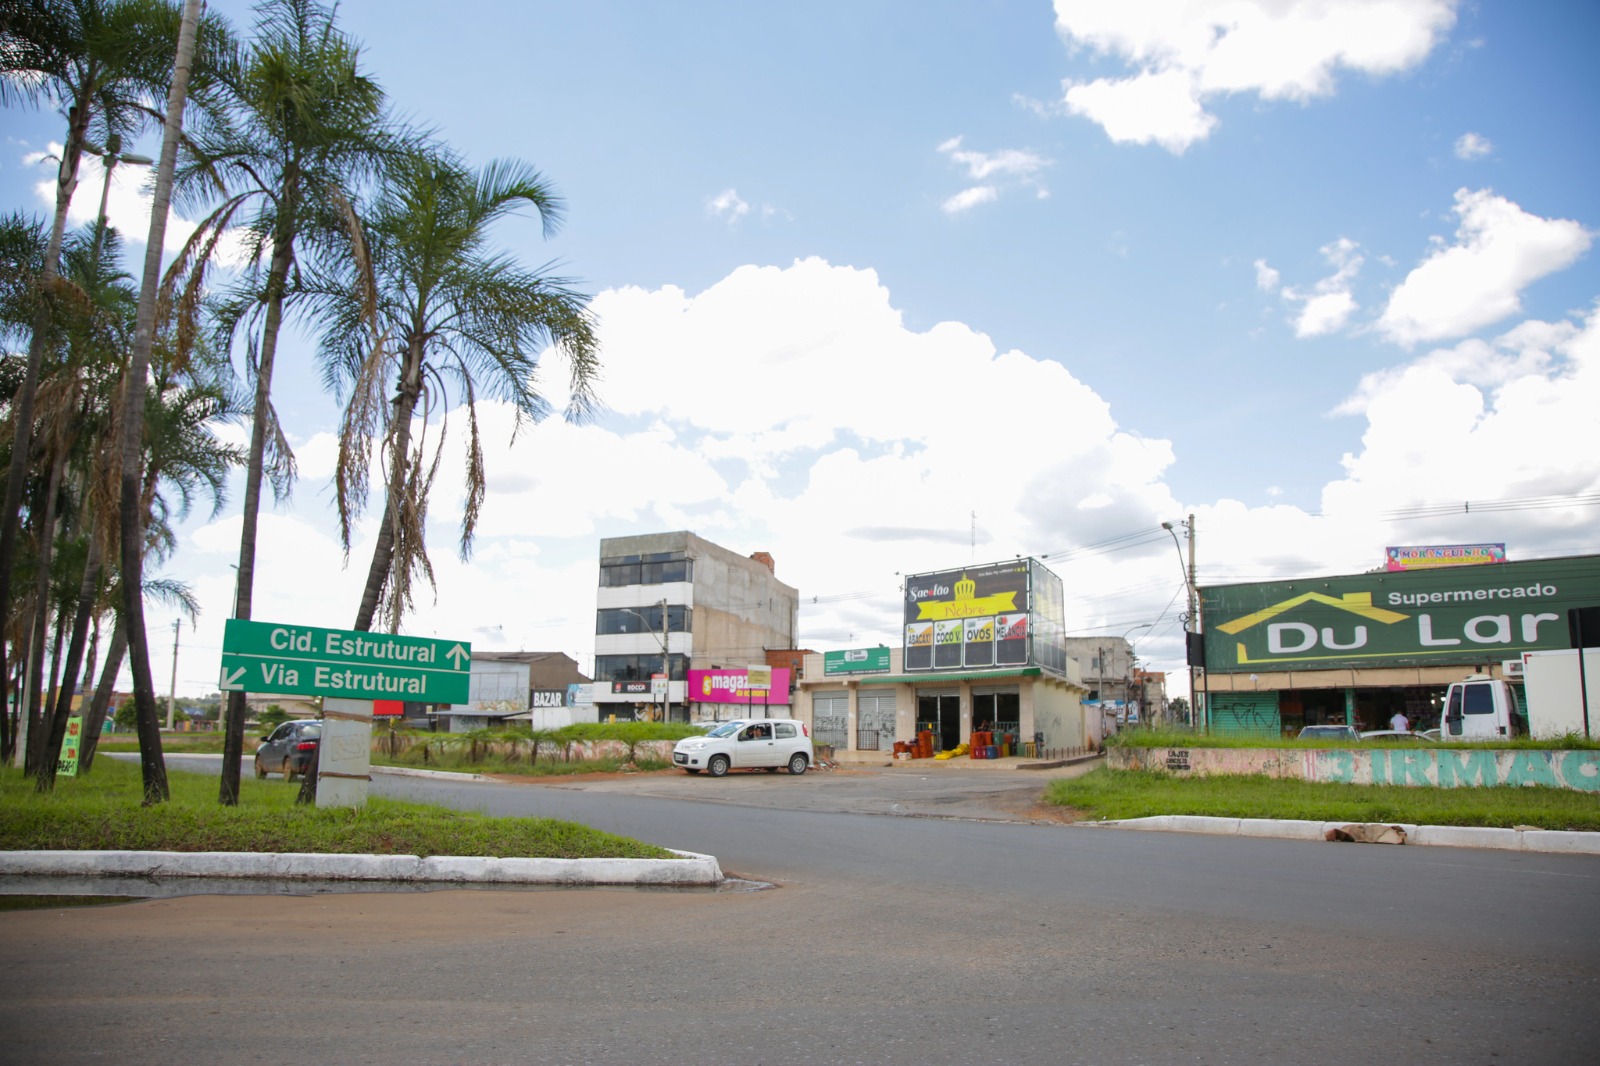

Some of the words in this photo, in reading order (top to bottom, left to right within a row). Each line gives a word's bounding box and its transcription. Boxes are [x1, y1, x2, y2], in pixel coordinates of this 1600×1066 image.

[1402, 548, 1489, 558] MORANGUINHO
[1388, 583, 1557, 606] Supermercado
[945, 603, 985, 617] Nobre
[967, 628, 991, 641] OVOS
[996, 625, 1026, 638] MELANCIA
[1418, 612, 1559, 647] Lar
[908, 634, 930, 644] ABACAXI
[936, 631, 954, 643] COCO
[270, 628, 317, 652] Cid.
[325, 633, 436, 663] Estrutural
[260, 662, 298, 686] Via
[314, 666, 426, 694] Estrutural
[533, 692, 562, 707] BAZAR
